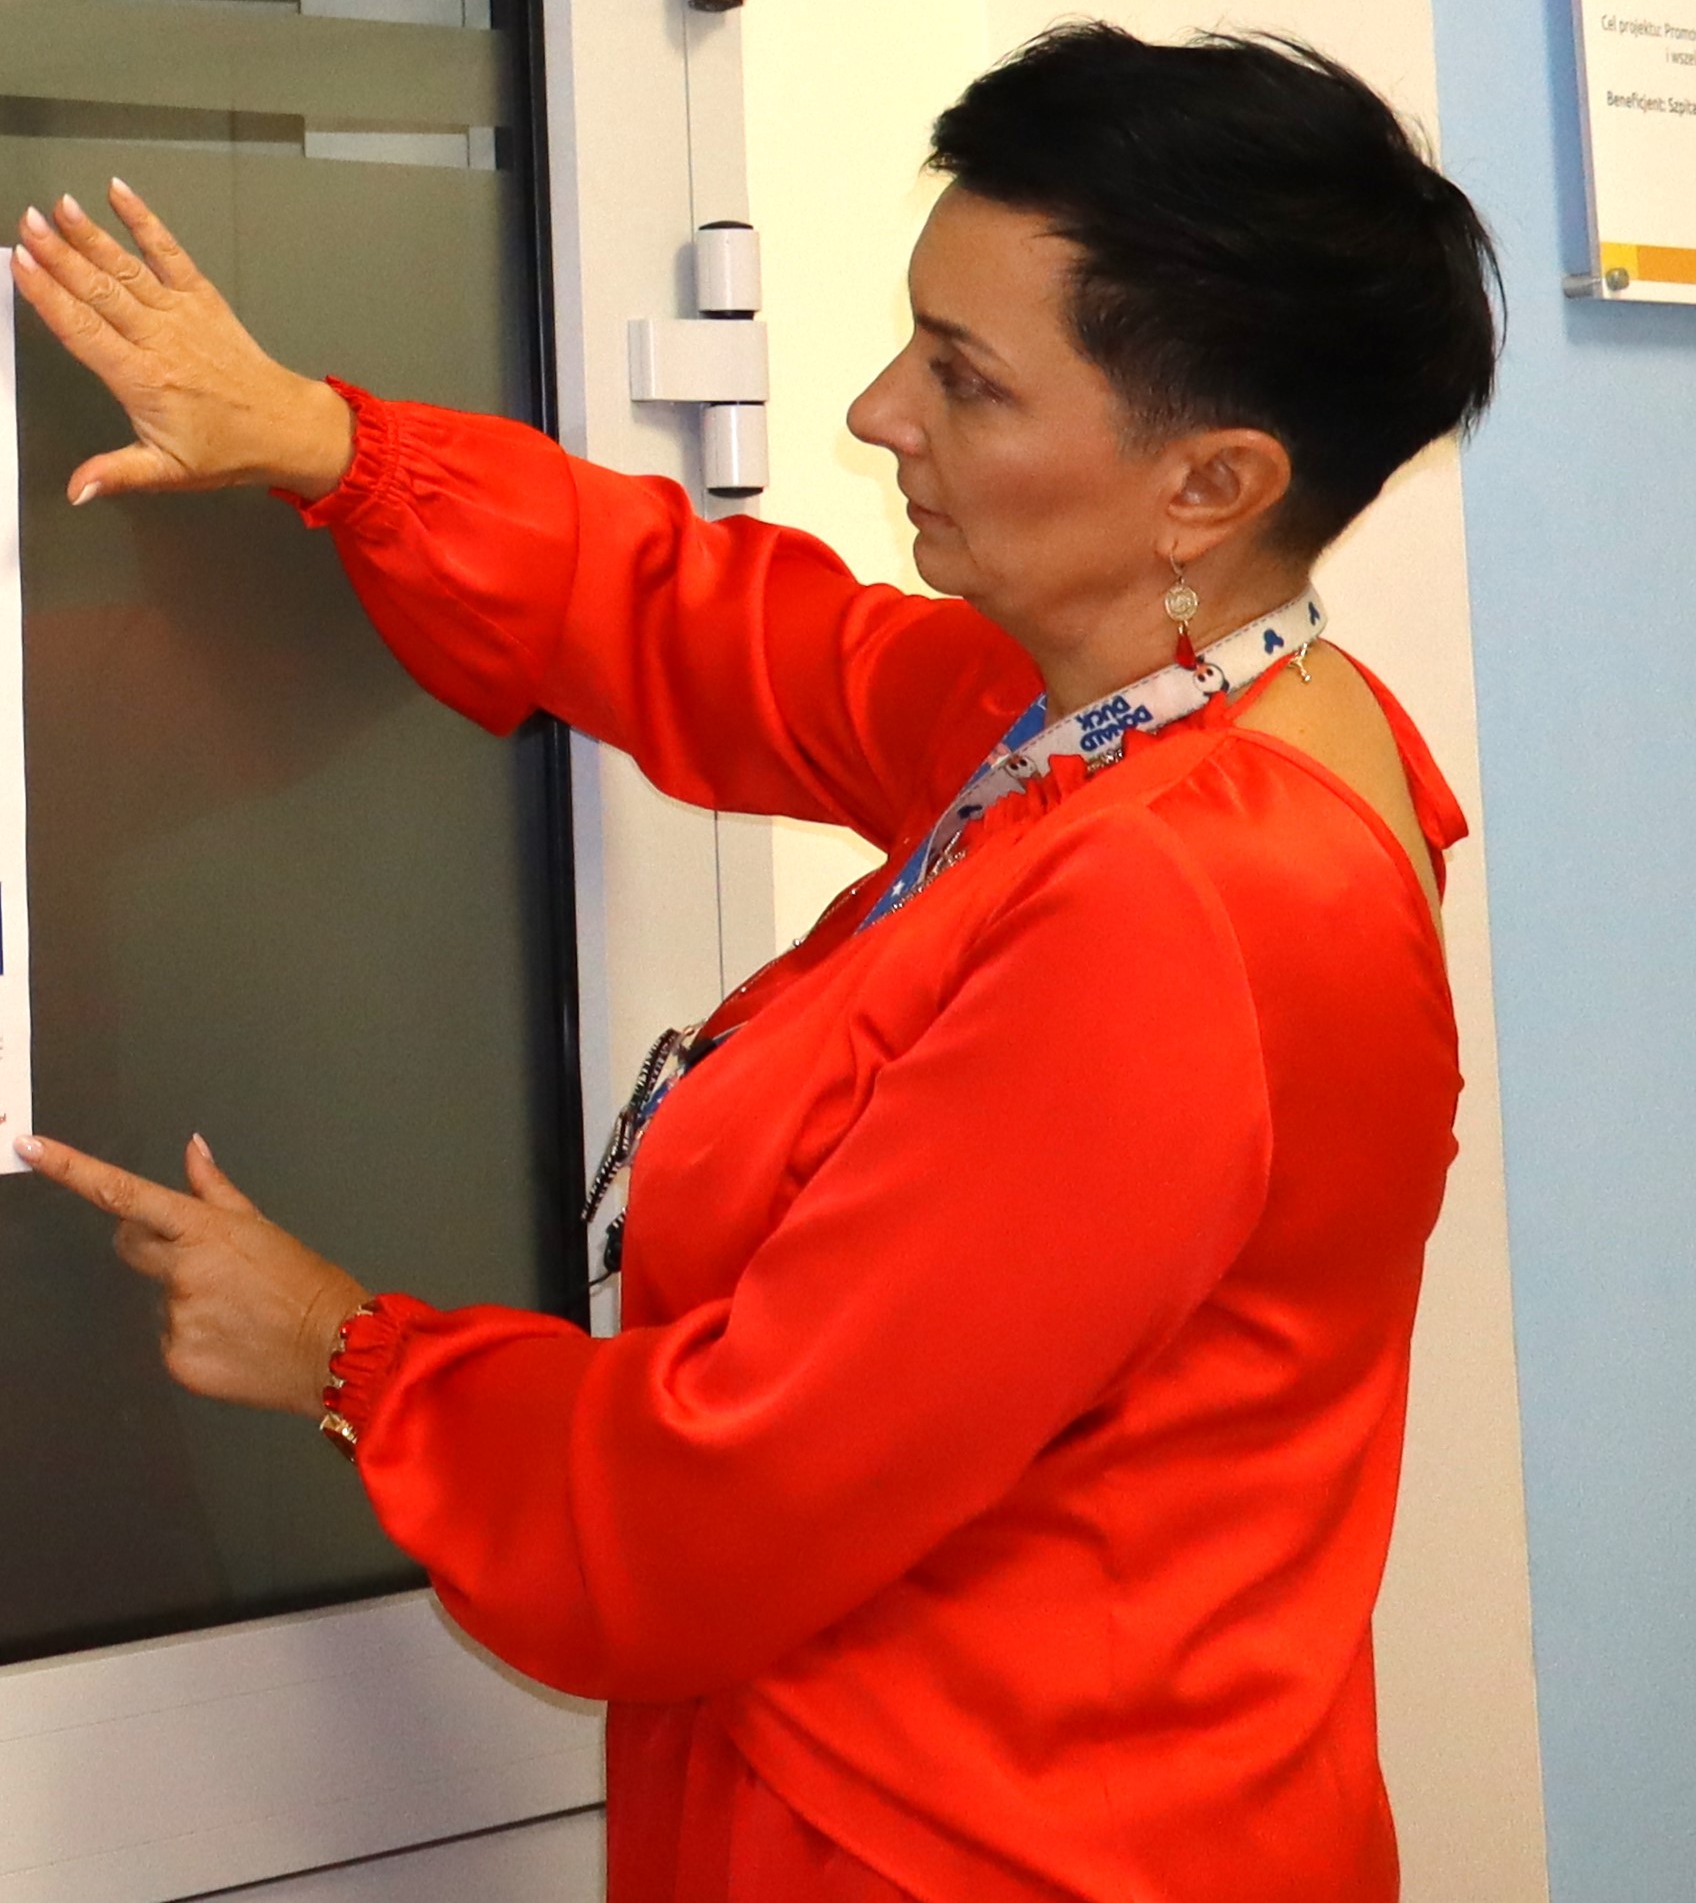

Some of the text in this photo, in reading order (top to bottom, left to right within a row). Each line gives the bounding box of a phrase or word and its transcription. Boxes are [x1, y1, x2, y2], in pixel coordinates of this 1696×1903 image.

[1601, 14, 1616, 31] Cel
[1075, 696, 1131, 732] DUCK
[1080, 705, 1154, 752] DONALD
